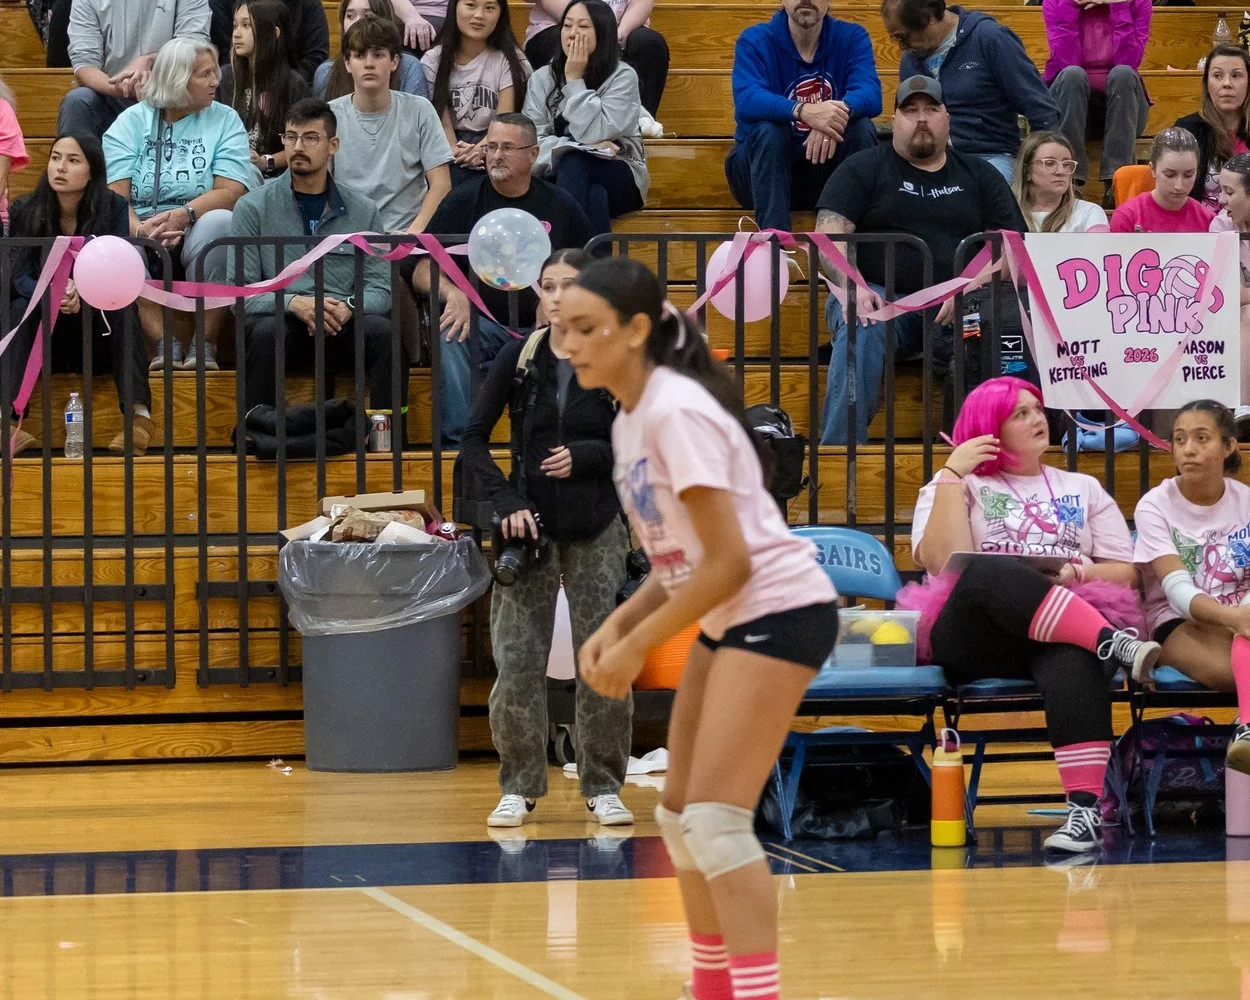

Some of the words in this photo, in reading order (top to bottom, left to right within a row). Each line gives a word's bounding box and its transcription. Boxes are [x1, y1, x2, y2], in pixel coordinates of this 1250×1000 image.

[927, 185, 964, 198] Hutson
[1056, 248, 1164, 310] DIG
[1106, 291, 1203, 334] PINK
[1056, 339, 1101, 358] MOTT
[1123, 347, 1159, 364] 2026
[1194, 354, 1208, 365] VS
[1048, 361, 1108, 385] KETTERING
[1181, 365, 1226, 383] PIERCE
